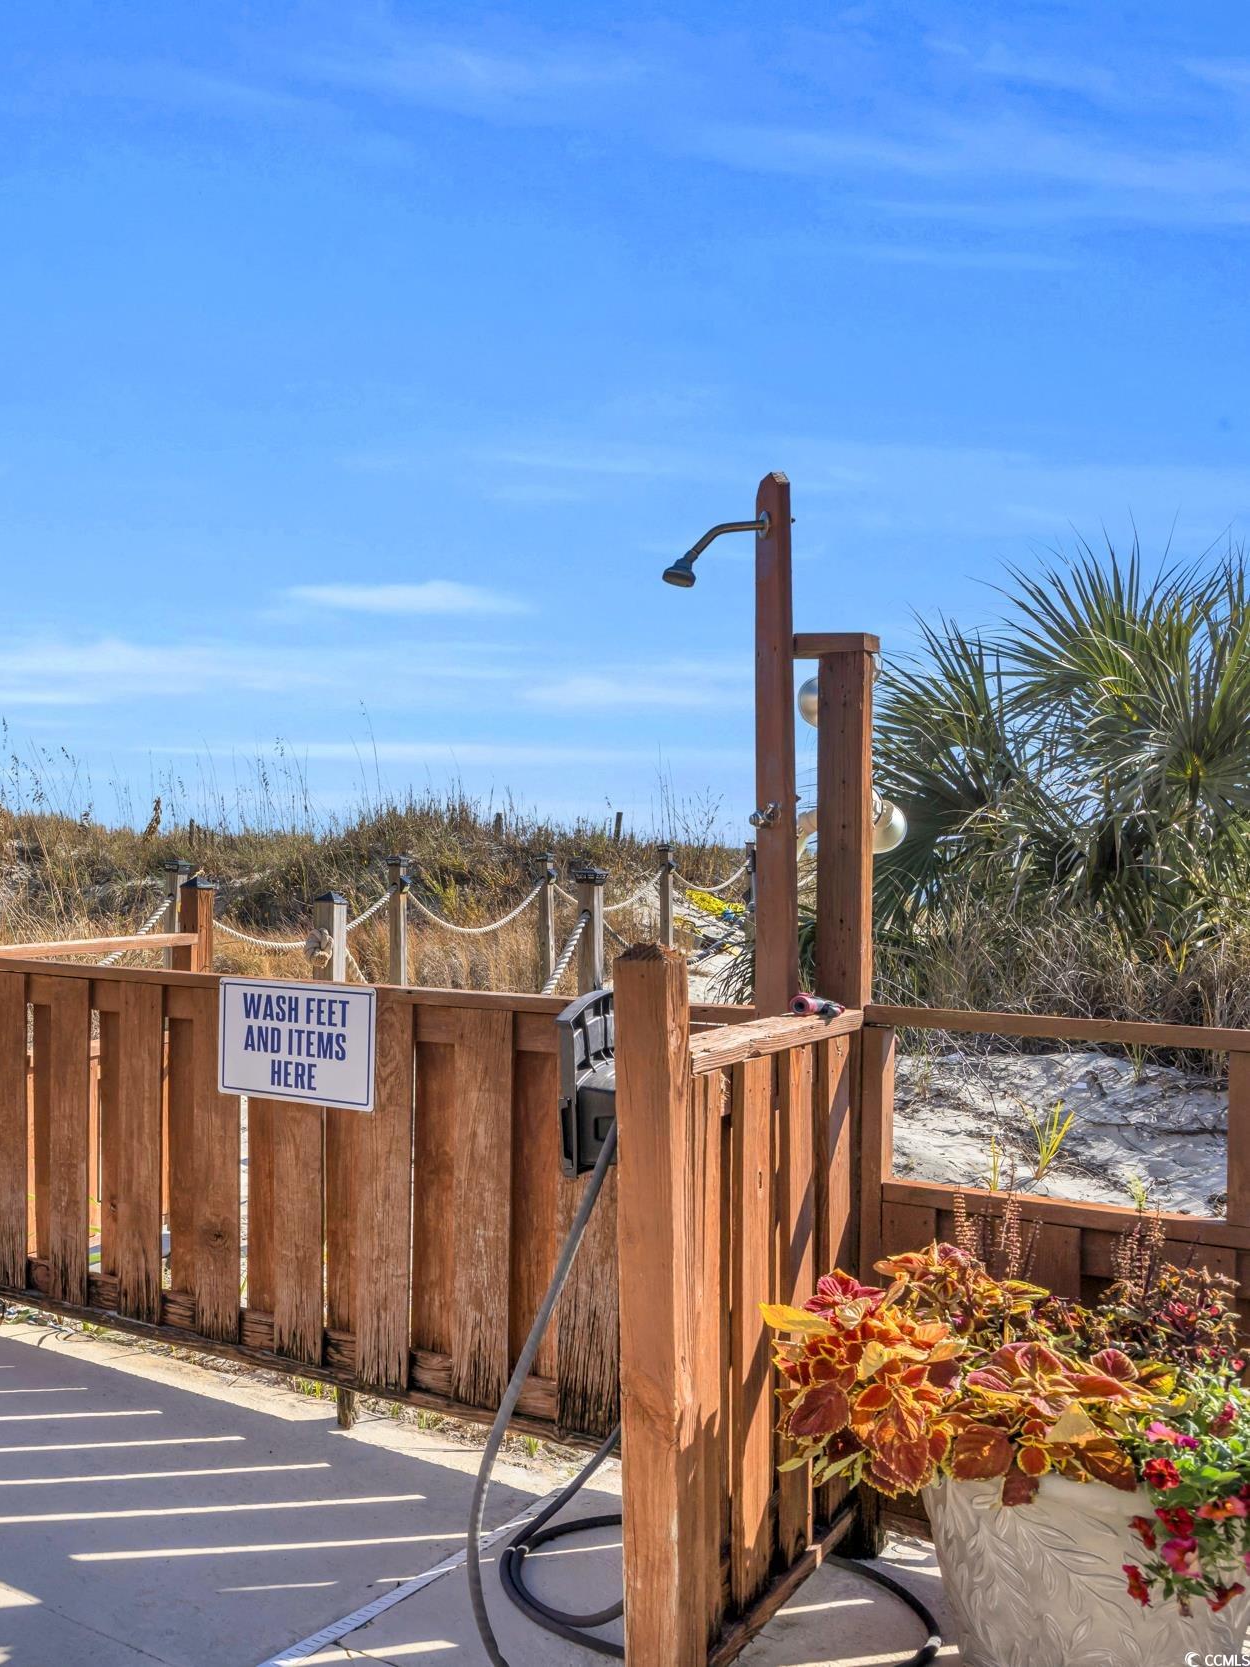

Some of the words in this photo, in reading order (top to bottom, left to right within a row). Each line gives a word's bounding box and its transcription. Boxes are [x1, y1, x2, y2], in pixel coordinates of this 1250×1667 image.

[243, 992, 299, 1024] WASH
[306, 997, 350, 1028] FEET
[244, 1024, 281, 1054] AND
[288, 1028, 347, 1061] ITEMS
[270, 1059, 317, 1091] HERE
